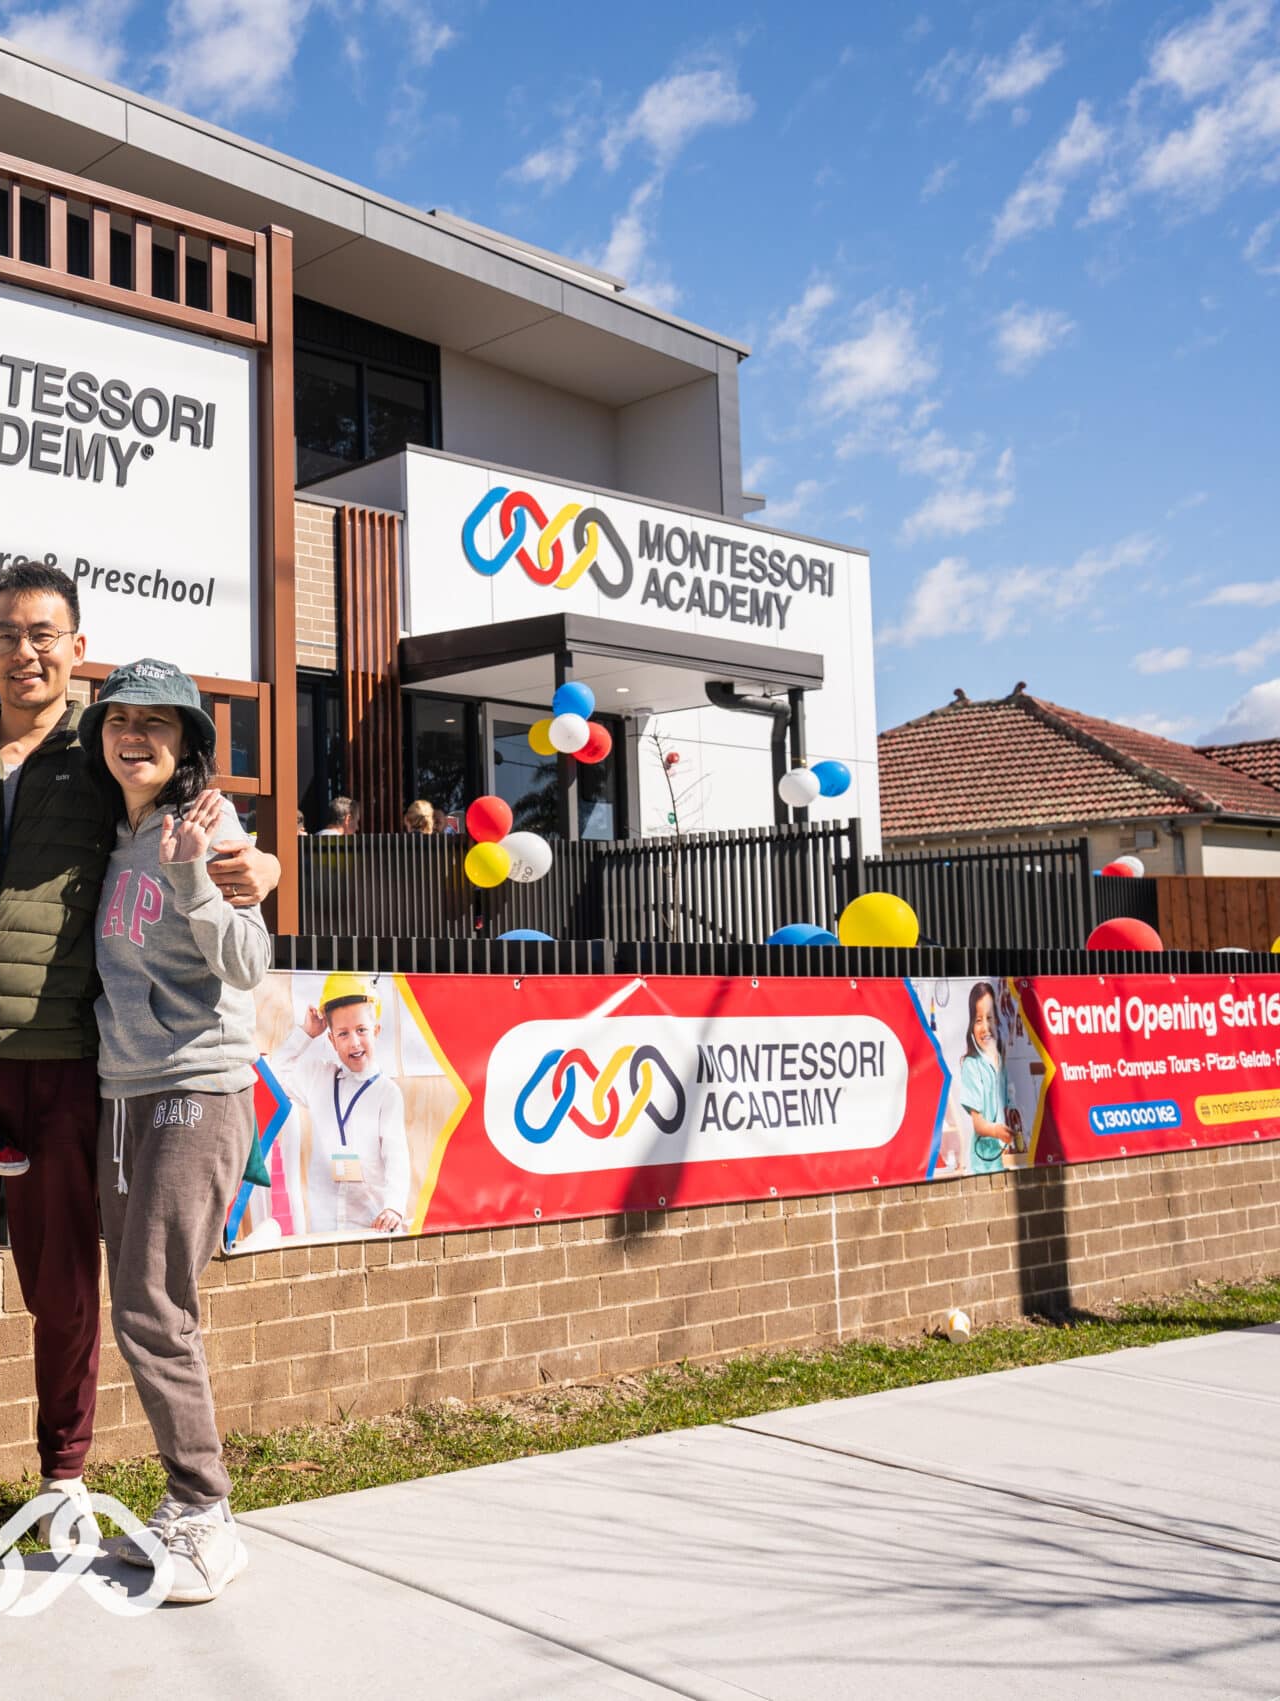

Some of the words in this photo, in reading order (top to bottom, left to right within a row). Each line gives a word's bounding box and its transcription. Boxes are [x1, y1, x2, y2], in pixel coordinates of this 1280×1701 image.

[73, 557, 216, 607] Preschool
[639, 520, 835, 598] MONTESSORI
[640, 567, 792, 630] ACADEMY
[102, 869, 164, 948] AP
[1042, 997, 1121, 1035] Grand
[1125, 994, 1218, 1040] Opening
[1219, 993, 1258, 1028] Sat
[696, 1041, 885, 1084] MONTESSORI
[1060, 1060, 1113, 1083] 11am-1pm
[1117, 1058, 1167, 1079] Campus
[1167, 1055, 1201, 1074] Tours
[1238, 1050, 1272, 1068] Gelato
[153, 1098, 203, 1129] GAP
[699, 1087, 842, 1132] ACADEMY
[1102, 1109, 1131, 1129] 1300
[1131, 1107, 1156, 1126] 000
[1156, 1105, 1177, 1123] 162
